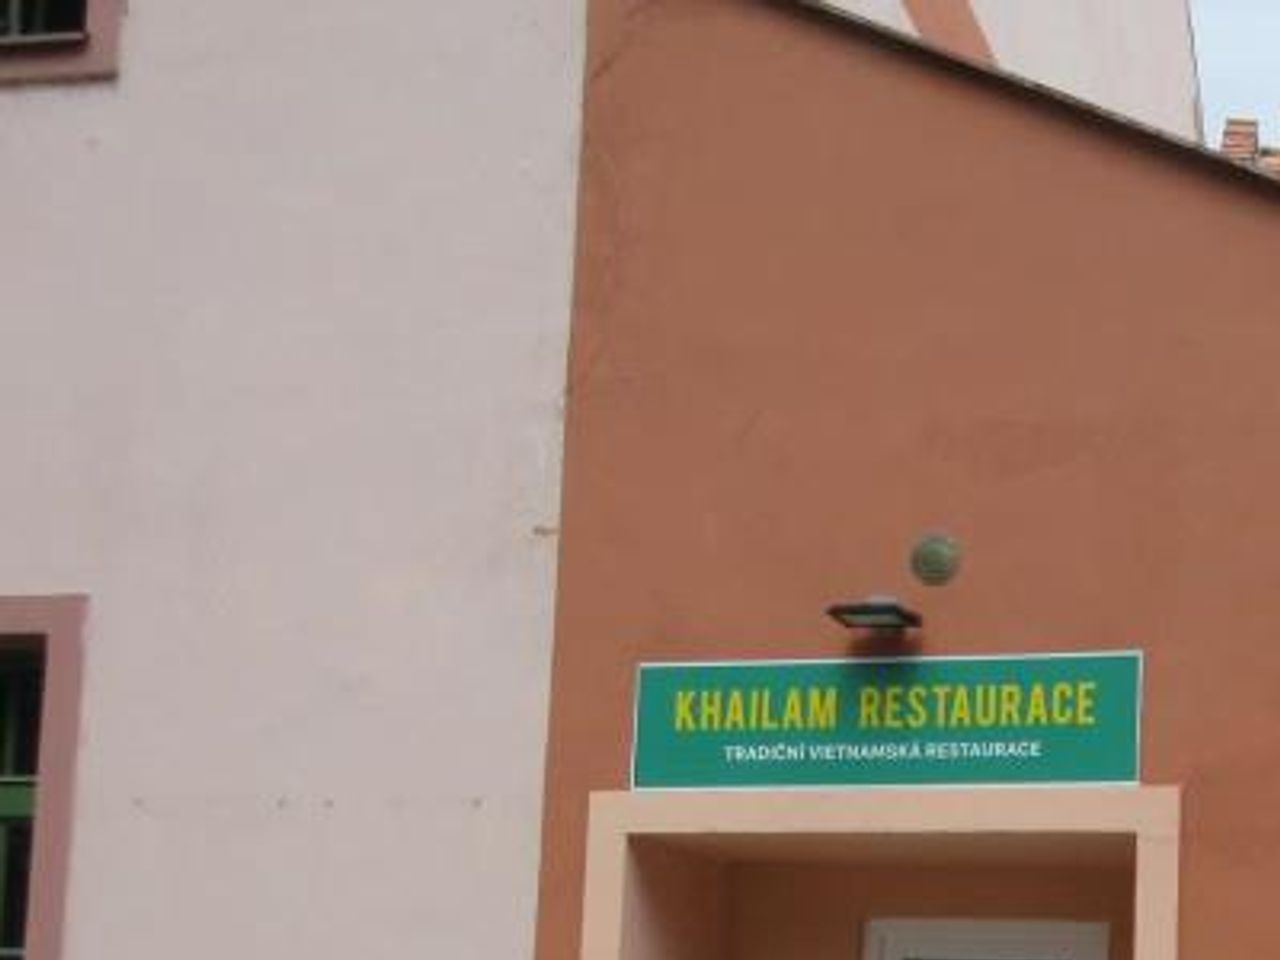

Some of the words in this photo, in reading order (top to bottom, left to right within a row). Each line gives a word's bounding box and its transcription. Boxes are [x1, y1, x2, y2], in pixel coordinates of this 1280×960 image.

[675, 687, 838, 731] KHAILAM
[859, 682, 1098, 728] RESTAURACE
[924, 741, 1042, 758] RESTAURACE
